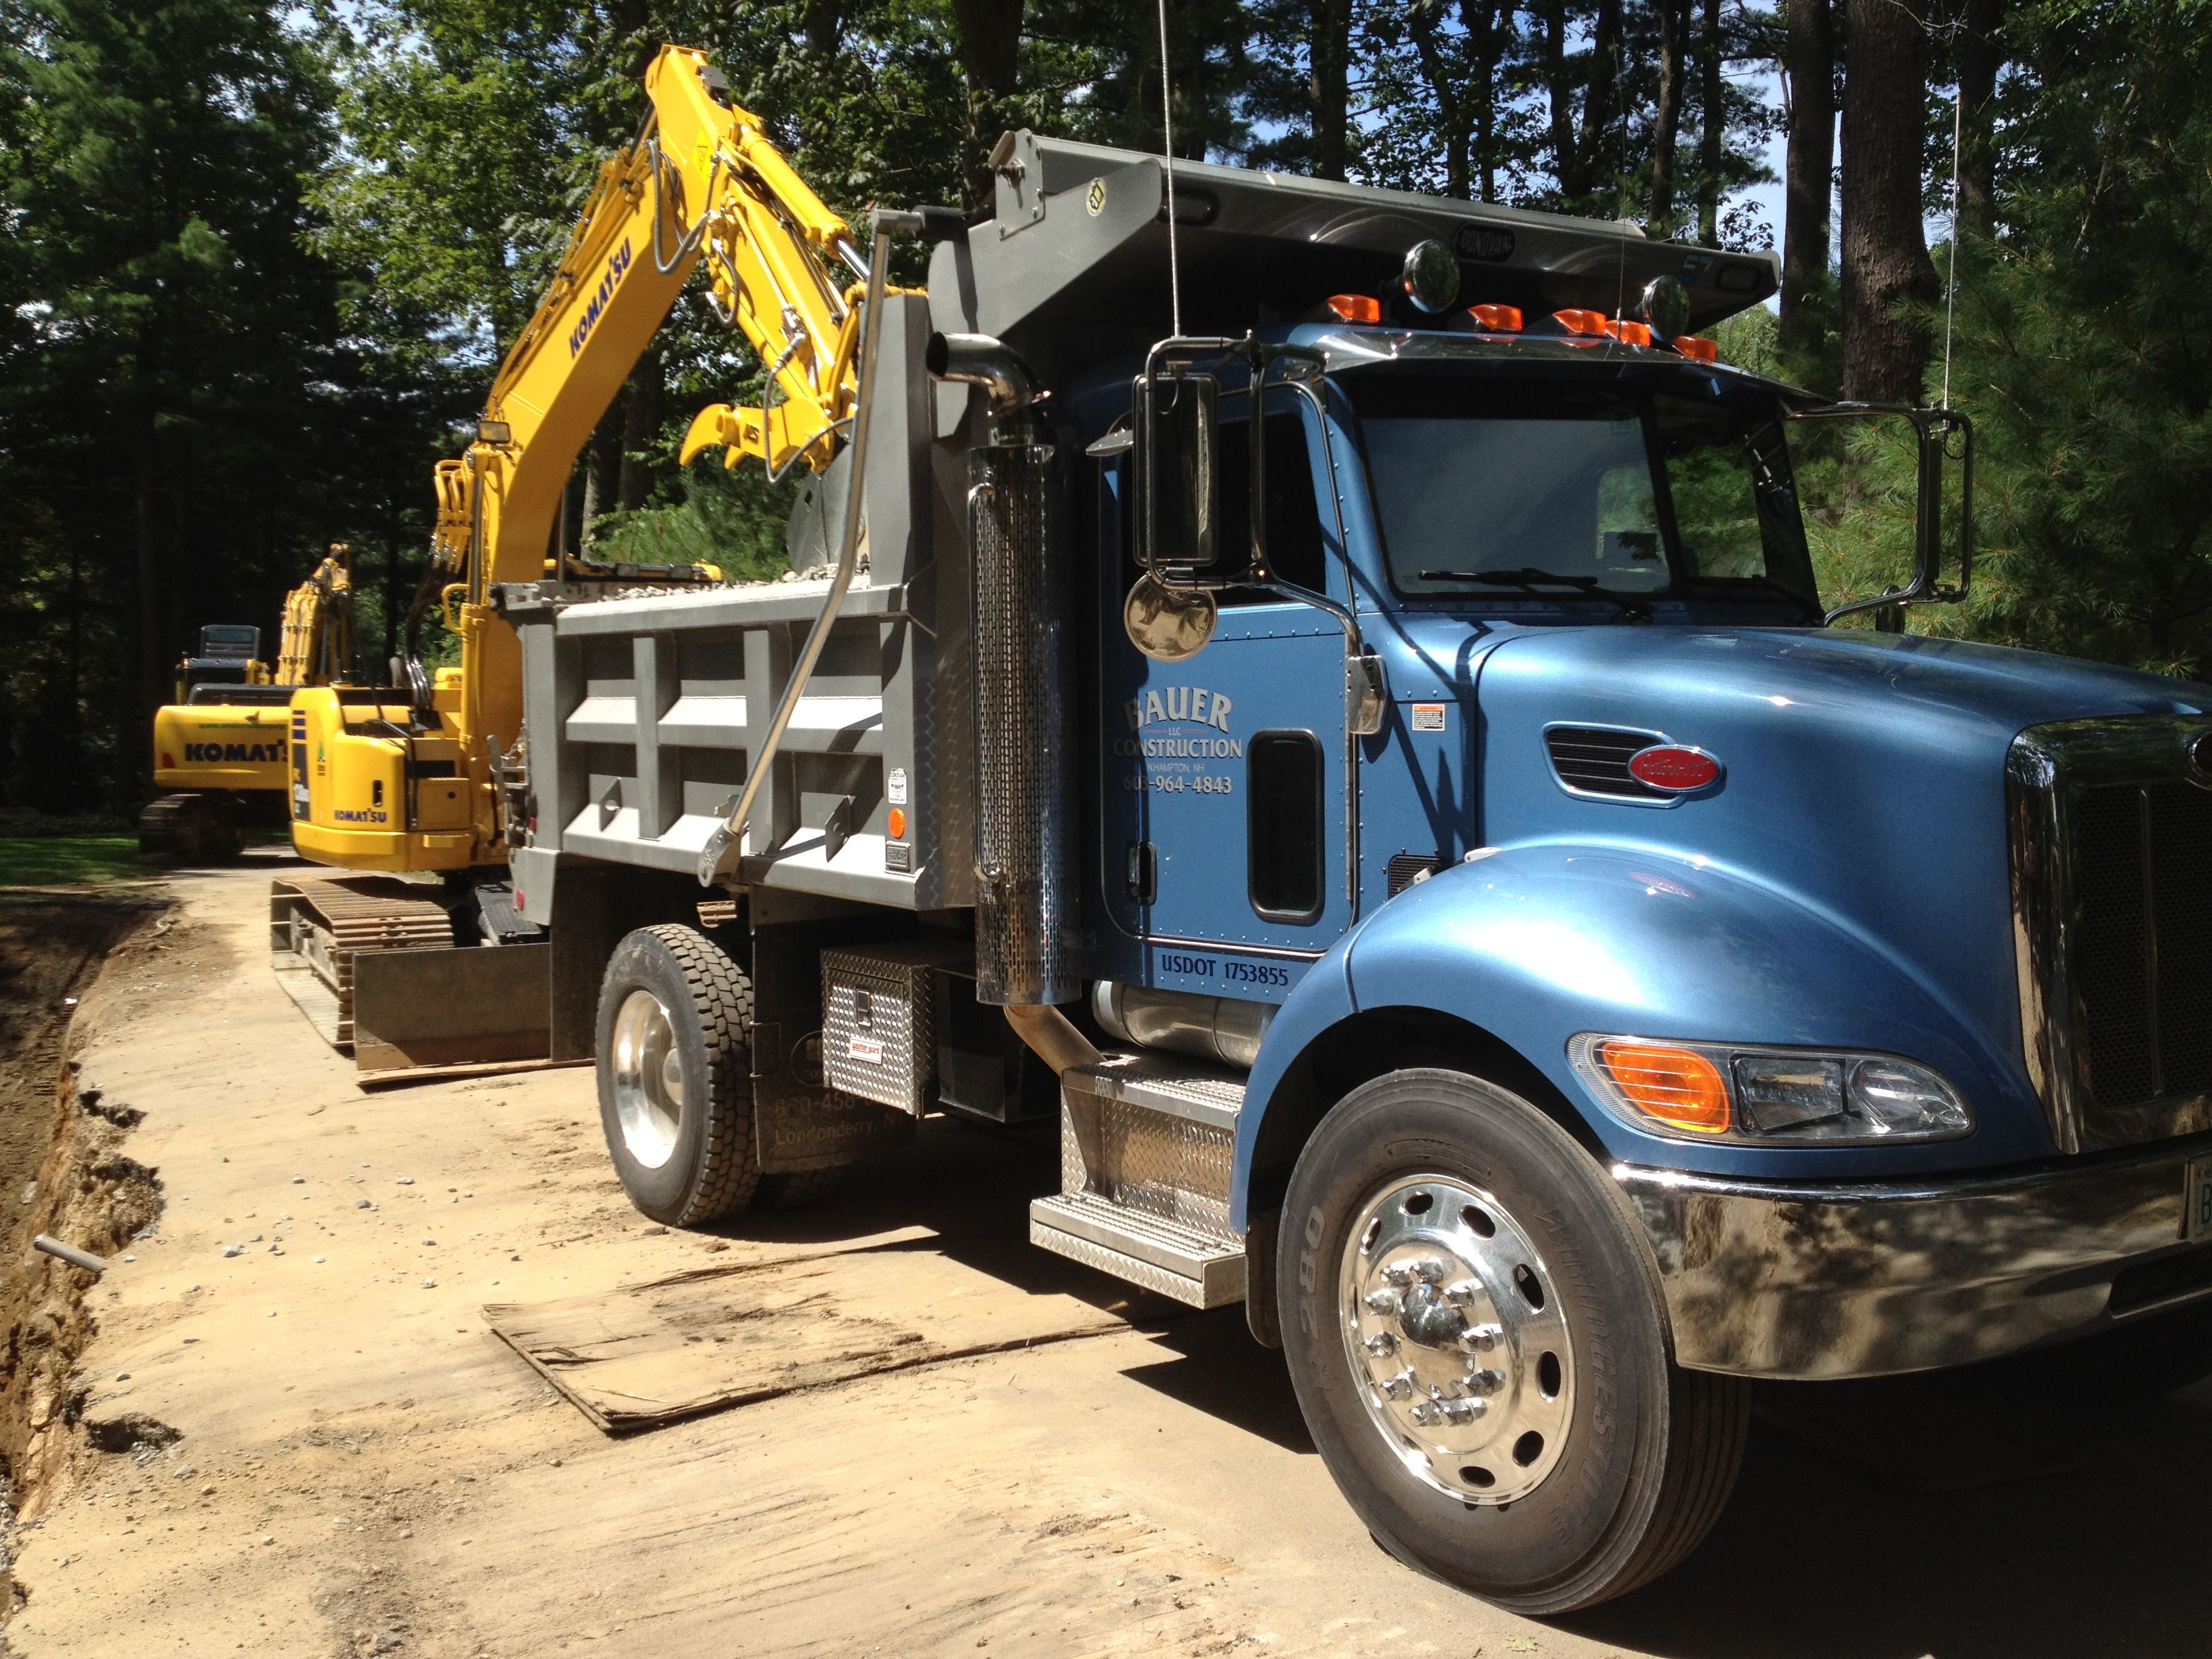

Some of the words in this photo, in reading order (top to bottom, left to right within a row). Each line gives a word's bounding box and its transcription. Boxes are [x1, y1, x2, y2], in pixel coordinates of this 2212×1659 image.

[1460, 228, 1513, 256] DONOVAN
[569, 235, 632, 360] KOMATSU
[1122, 686, 1233, 734] BAUER
[1168, 727, 1182, 736] LLC
[1113, 738, 1242, 759] CONSTRUCTION
[1193, 763, 1204, 773] NH
[1122, 775, 1233, 795] 603-964-4843
[333, 808, 388, 823] KOMATSU
[1161, 954, 1216, 978] USDOT
[1224, 961, 1289, 987] 1753855
